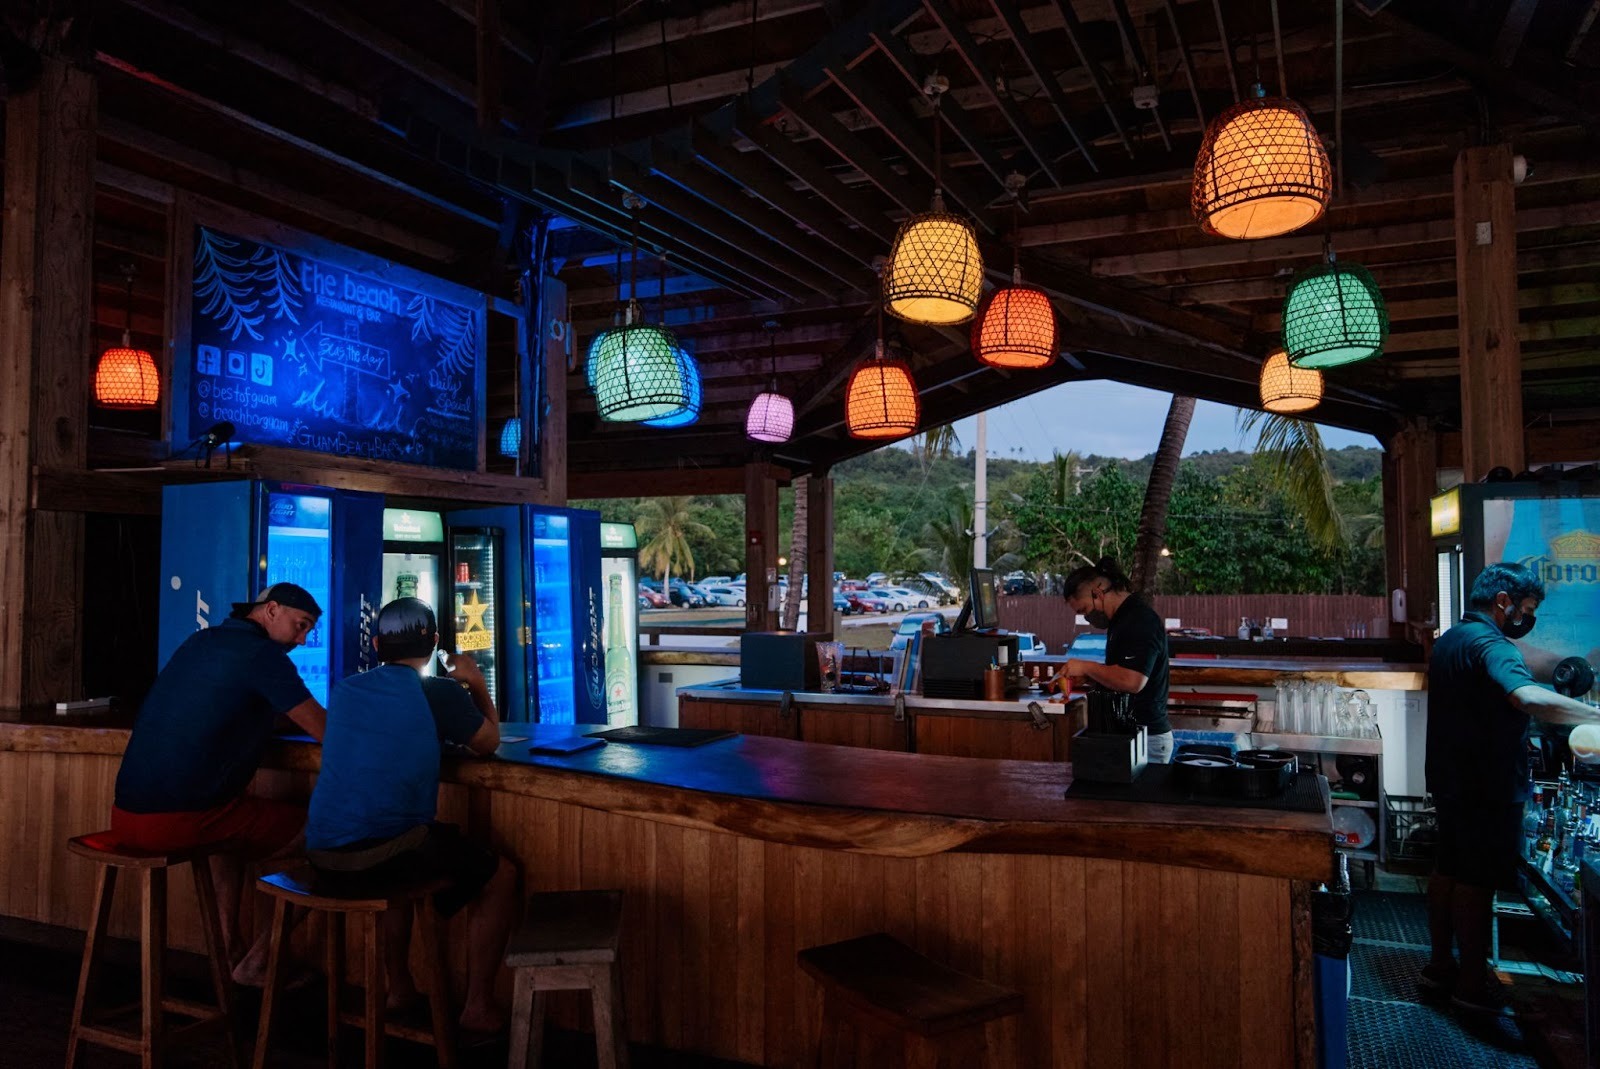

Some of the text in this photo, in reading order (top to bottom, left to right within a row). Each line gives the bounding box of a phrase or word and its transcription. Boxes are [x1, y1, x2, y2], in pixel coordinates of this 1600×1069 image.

[301, 261, 401, 315] the beach
[366, 306, 382, 323] BAR
[346, 344, 361, 363] the
[362, 347, 386, 371] day
[429, 368, 462, 399] Daily
[358, 593, 372, 674] LIGHT
